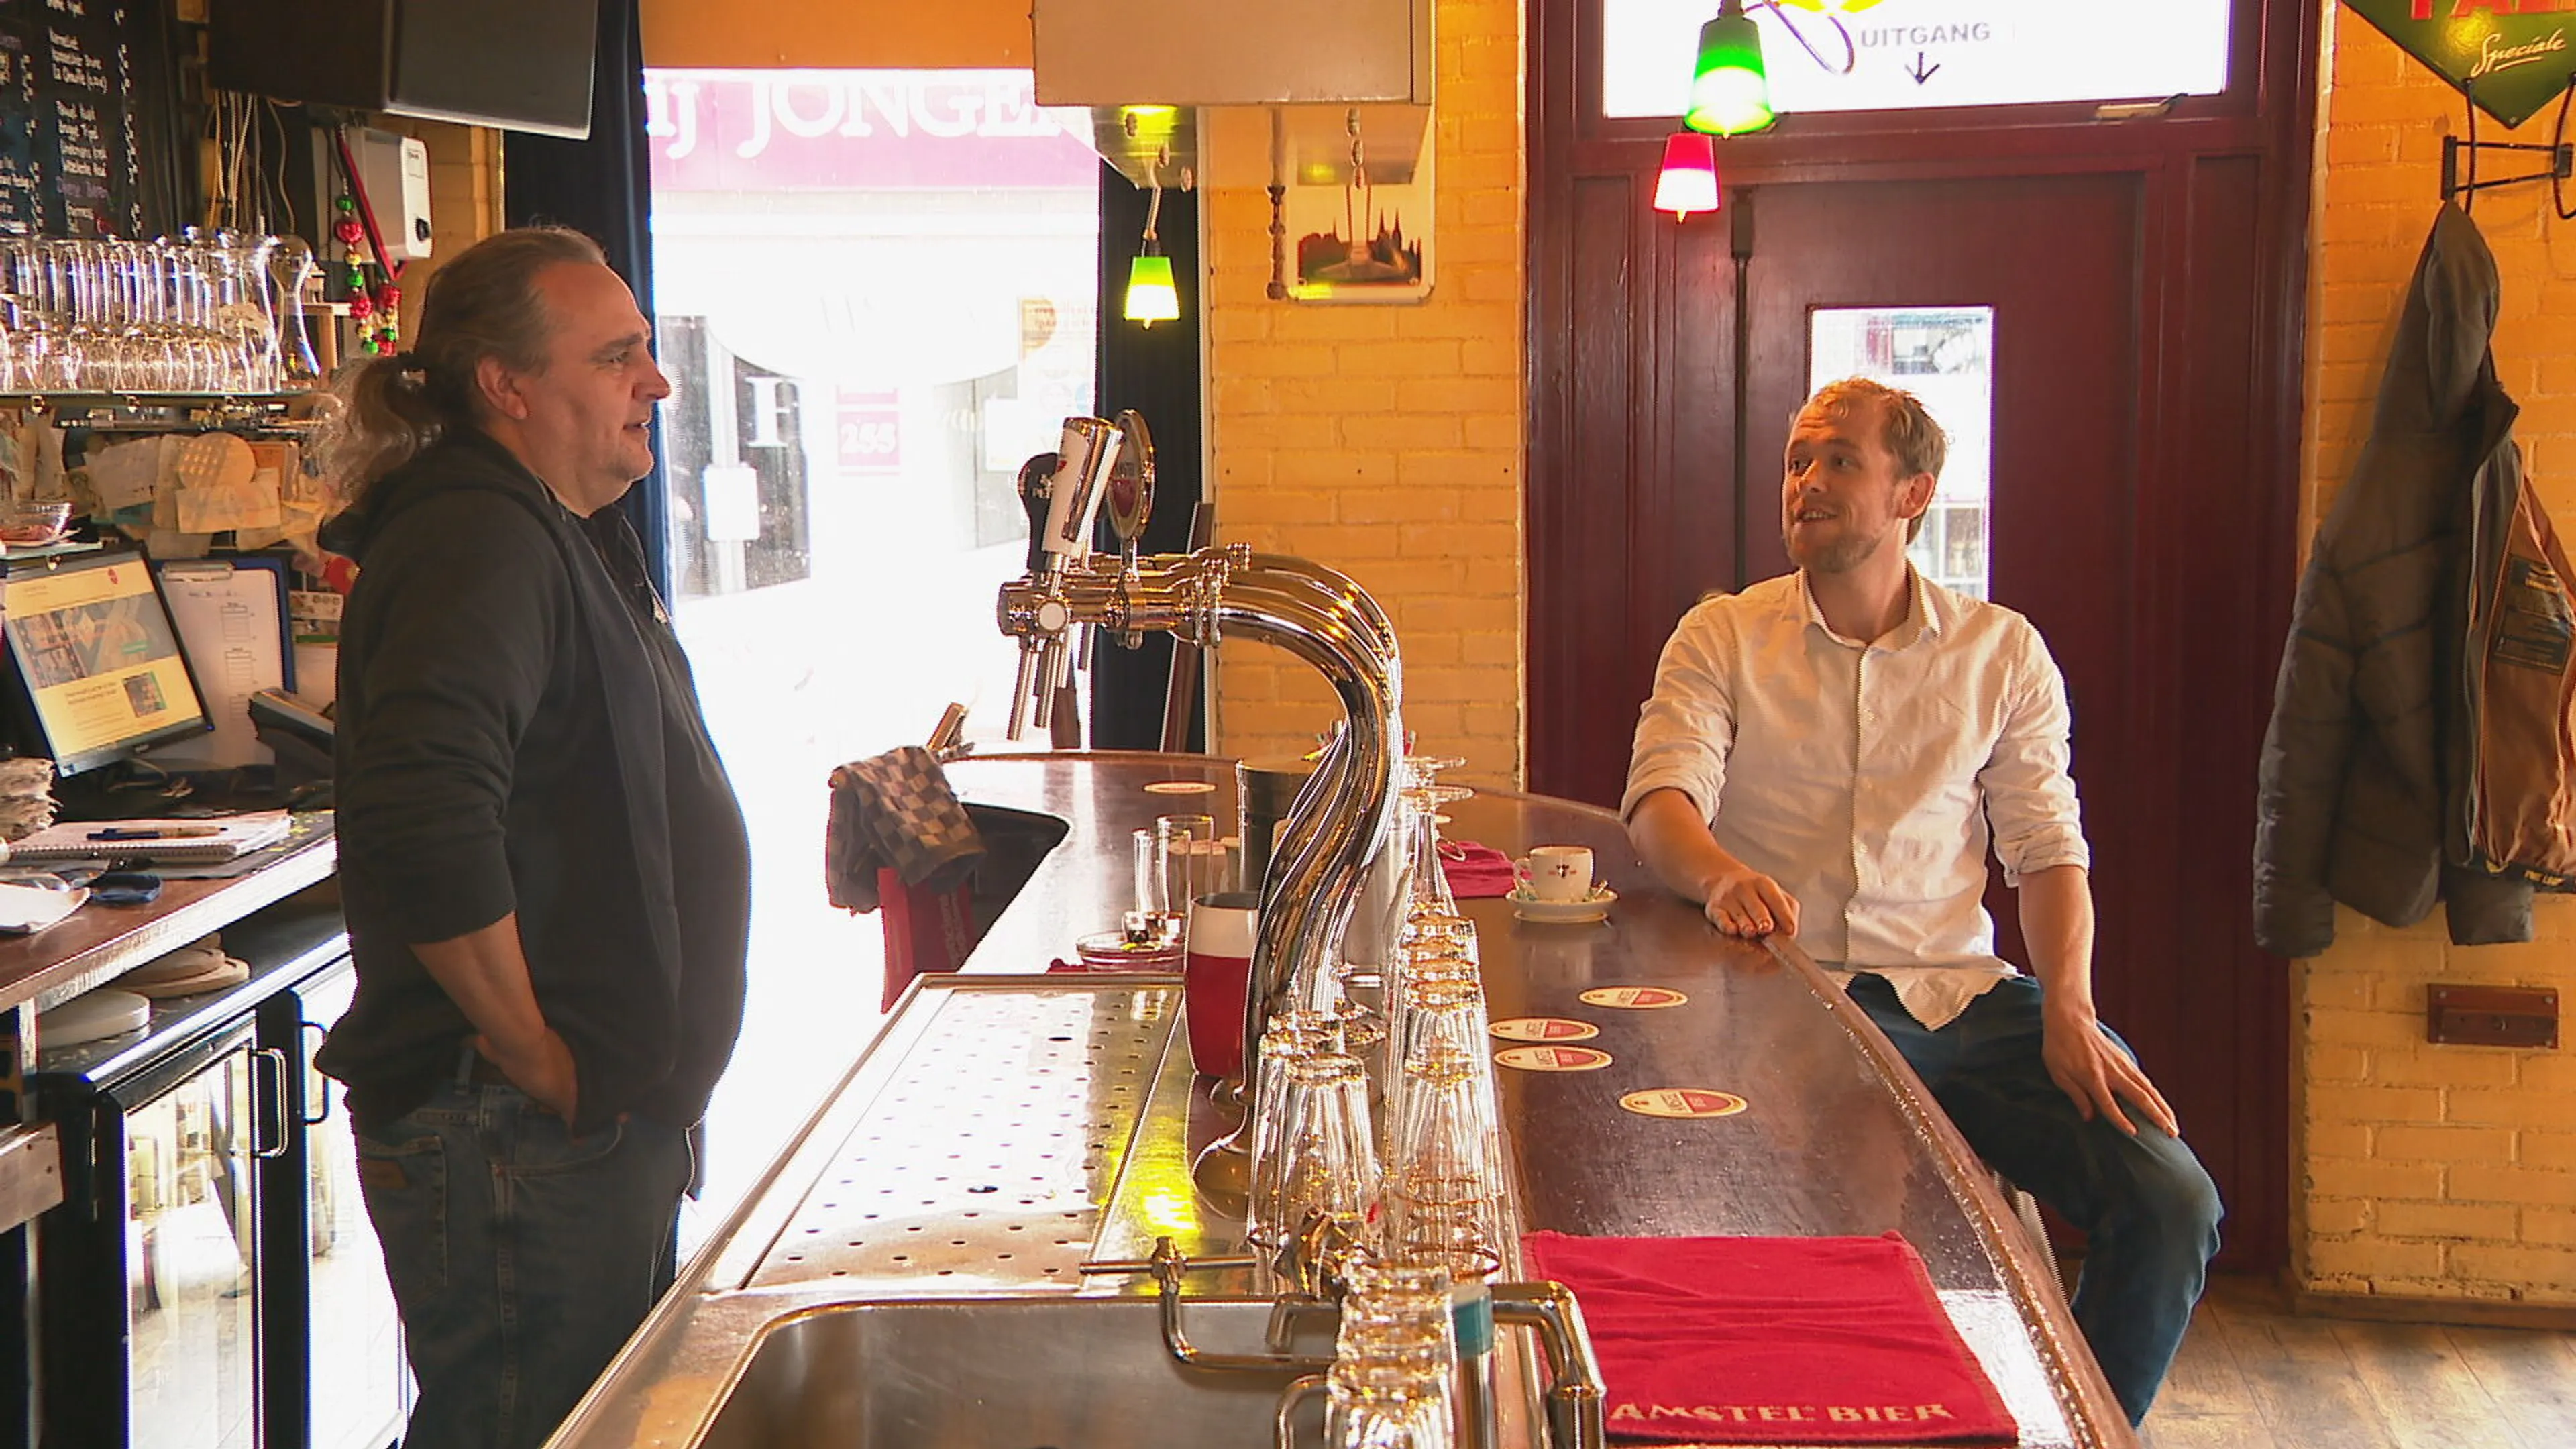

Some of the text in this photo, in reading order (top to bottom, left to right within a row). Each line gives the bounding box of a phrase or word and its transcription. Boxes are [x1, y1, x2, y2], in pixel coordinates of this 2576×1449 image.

[1860, 22, 1991, 48] UITGANG
[2469, 28, 2567, 78] Speciale
[1609, 1403, 1955, 1423] AMSTEL BIER
